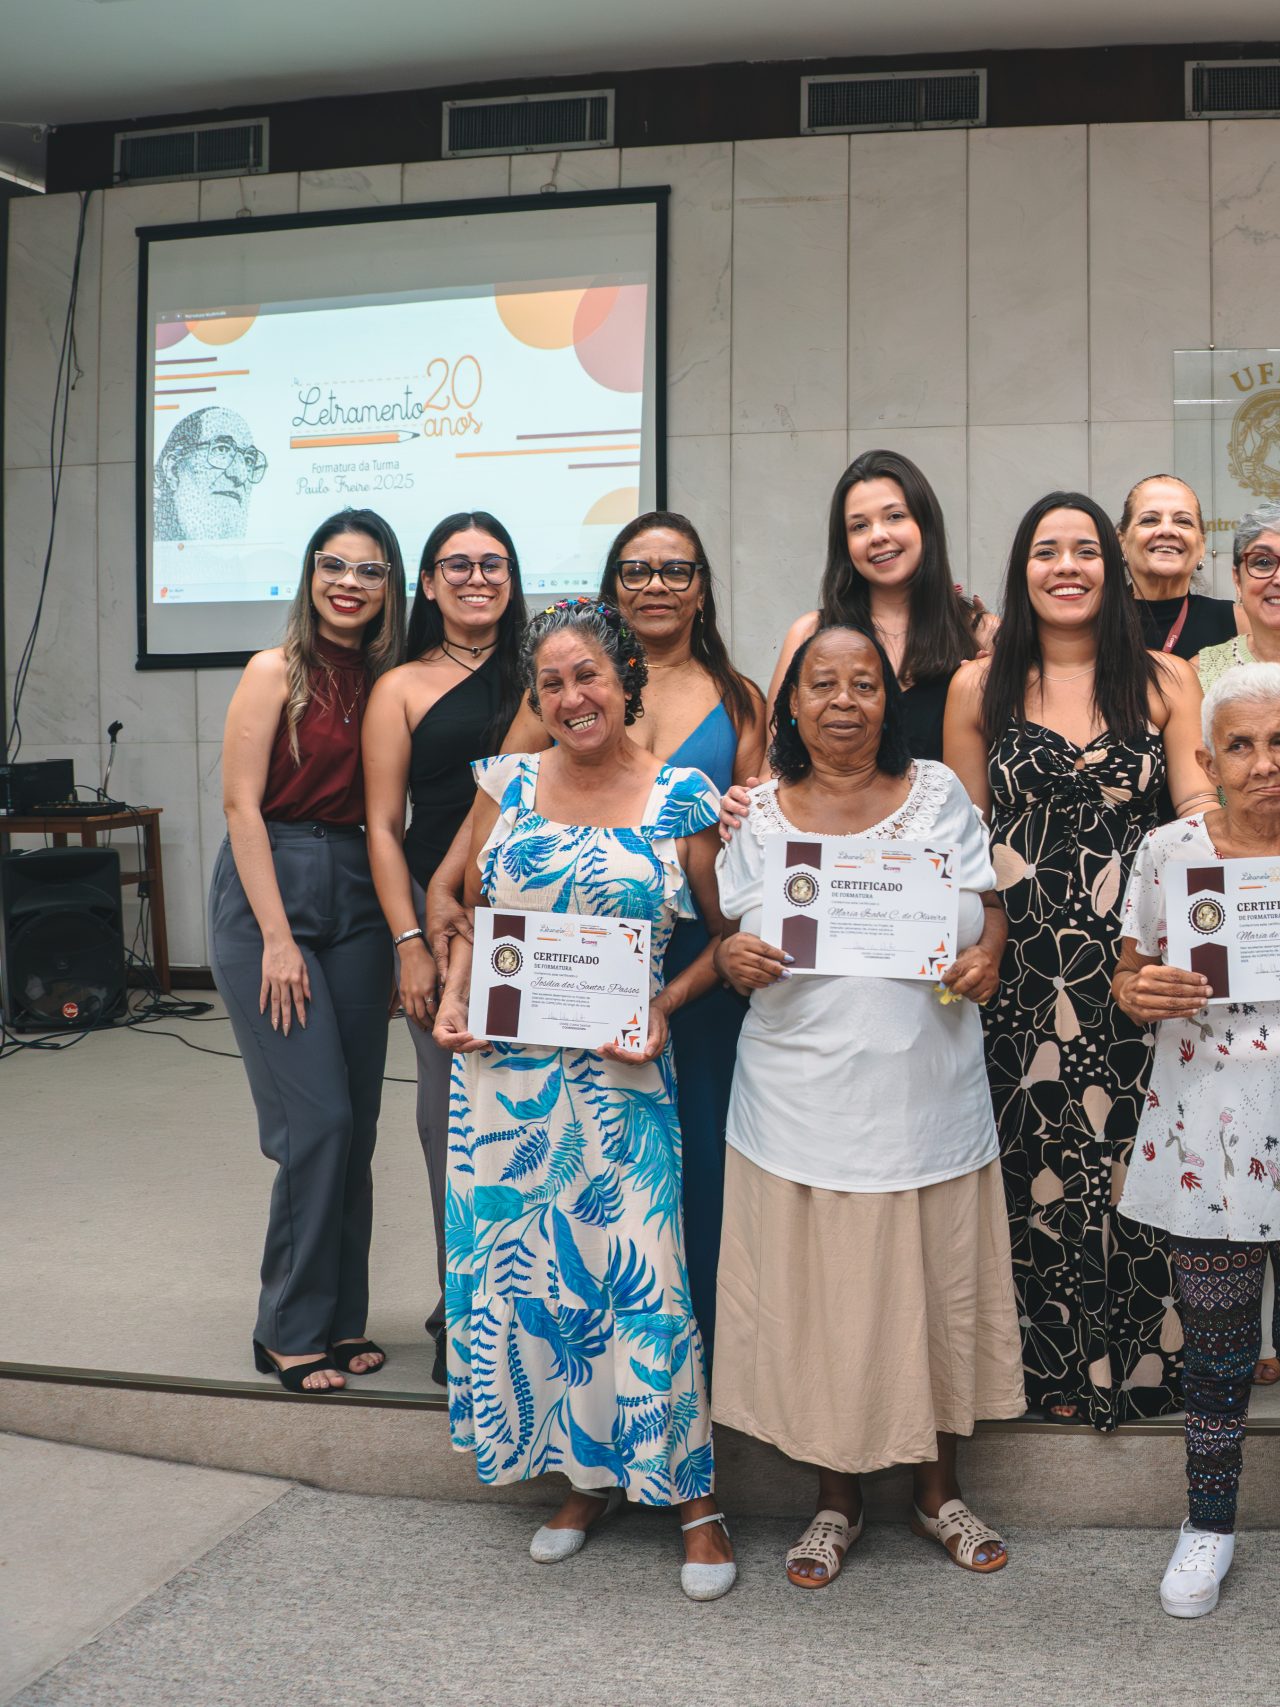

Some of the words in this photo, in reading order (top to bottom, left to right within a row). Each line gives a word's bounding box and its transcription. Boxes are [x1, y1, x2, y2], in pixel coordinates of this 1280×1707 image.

[291, 384, 425, 427] Letramento
[423, 354, 483, 411] 20
[423, 411, 483, 438] anos
[311, 462, 356, 473] Formatura
[358, 461, 370, 472] da
[373, 459, 400, 471] Turma
[295, 476, 330, 495] Paulo
[334, 474, 370, 494] Freire
[373, 473, 415, 491] 2025
[1205, 517, 1239, 532] ntro
[831, 880, 903, 892] CERTIFICADO
[1236, 931, 1268, 941] Maria
[533, 951, 600, 965] CERTIFICADO
[561, 981, 575, 989] dos
[576, 980, 605, 991] Santos
